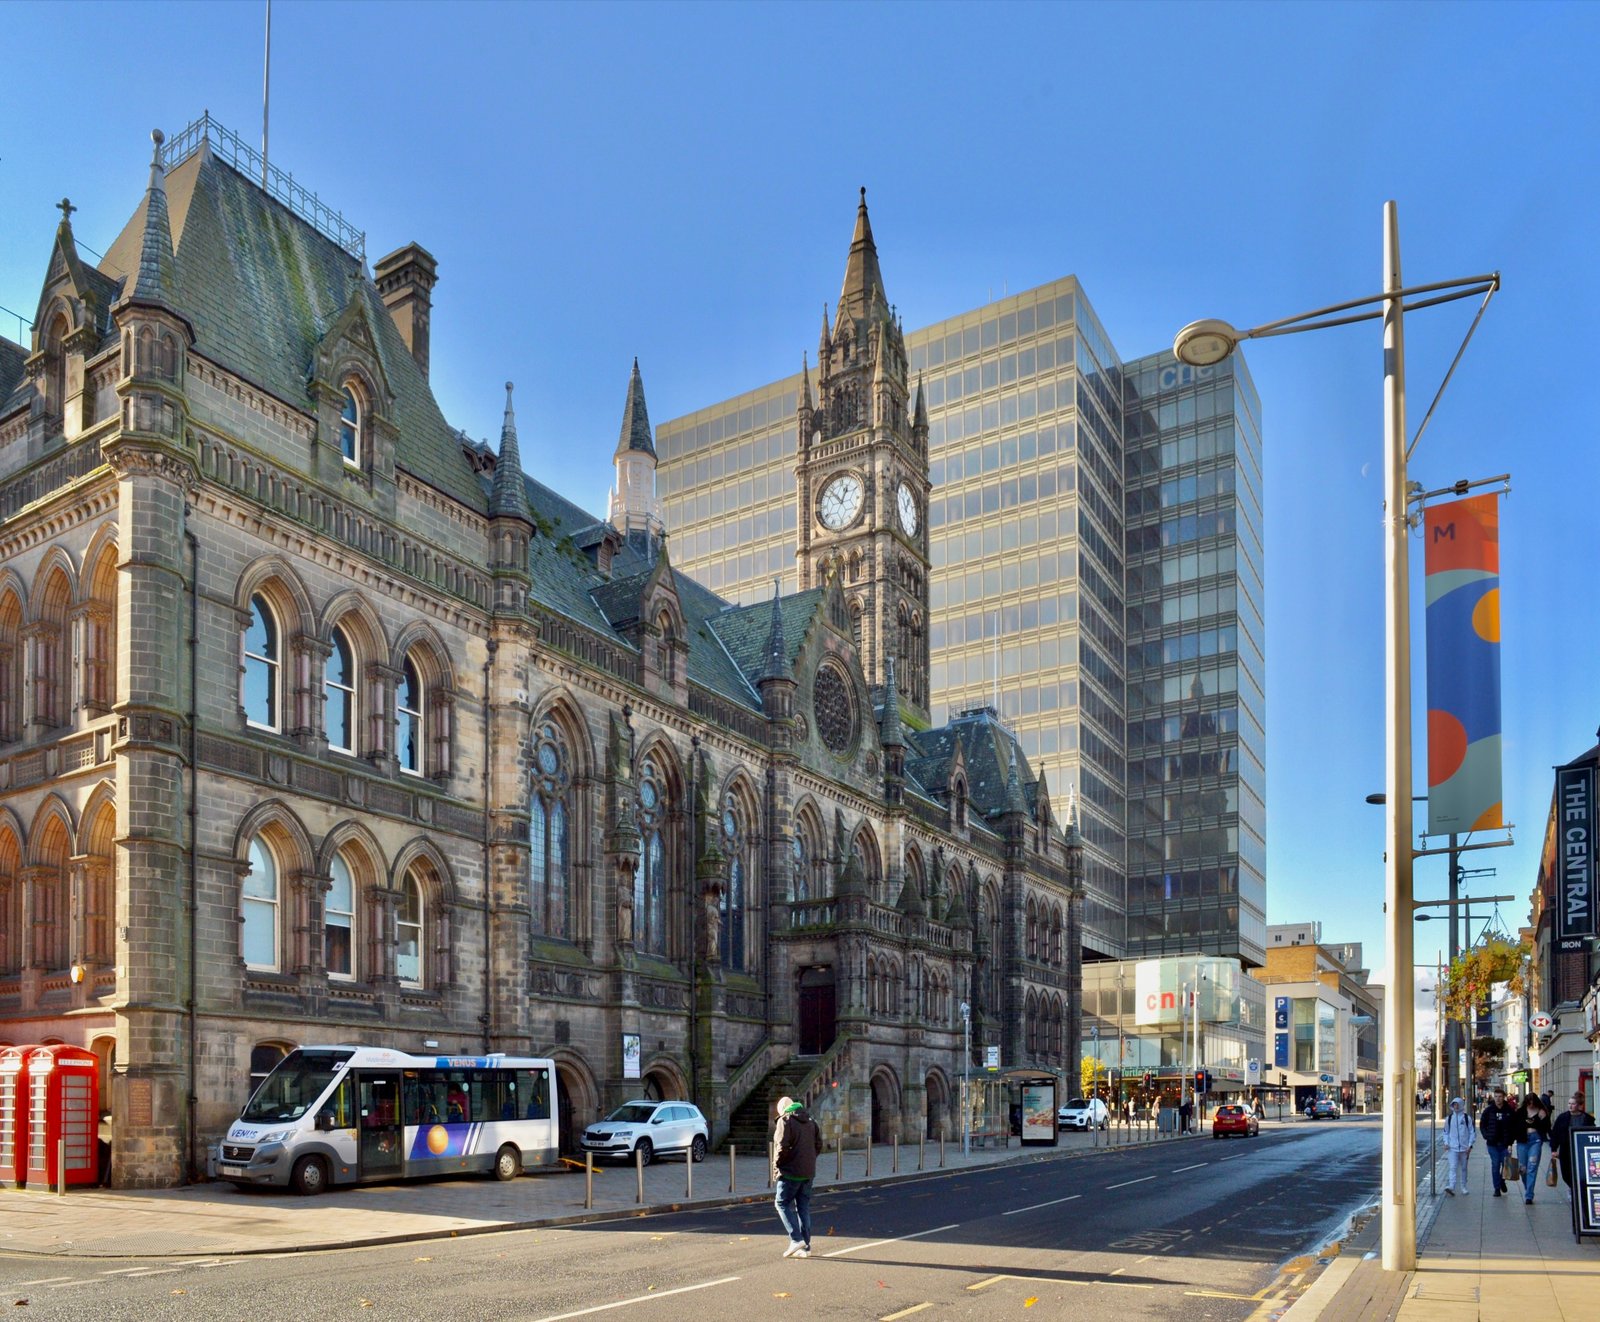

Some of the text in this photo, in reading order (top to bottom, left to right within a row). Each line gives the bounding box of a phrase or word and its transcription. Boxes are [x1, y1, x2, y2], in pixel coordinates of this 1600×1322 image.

[1433, 522, 1456, 544] M
[1565, 779, 1588, 925] THE CENTRAL
[1561, 941, 1581, 949] IRON
[1277, 998, 1285, 1008] P
[448, 1058, 477, 1067] VENUS
[231, 1129, 259, 1139] VENUS
